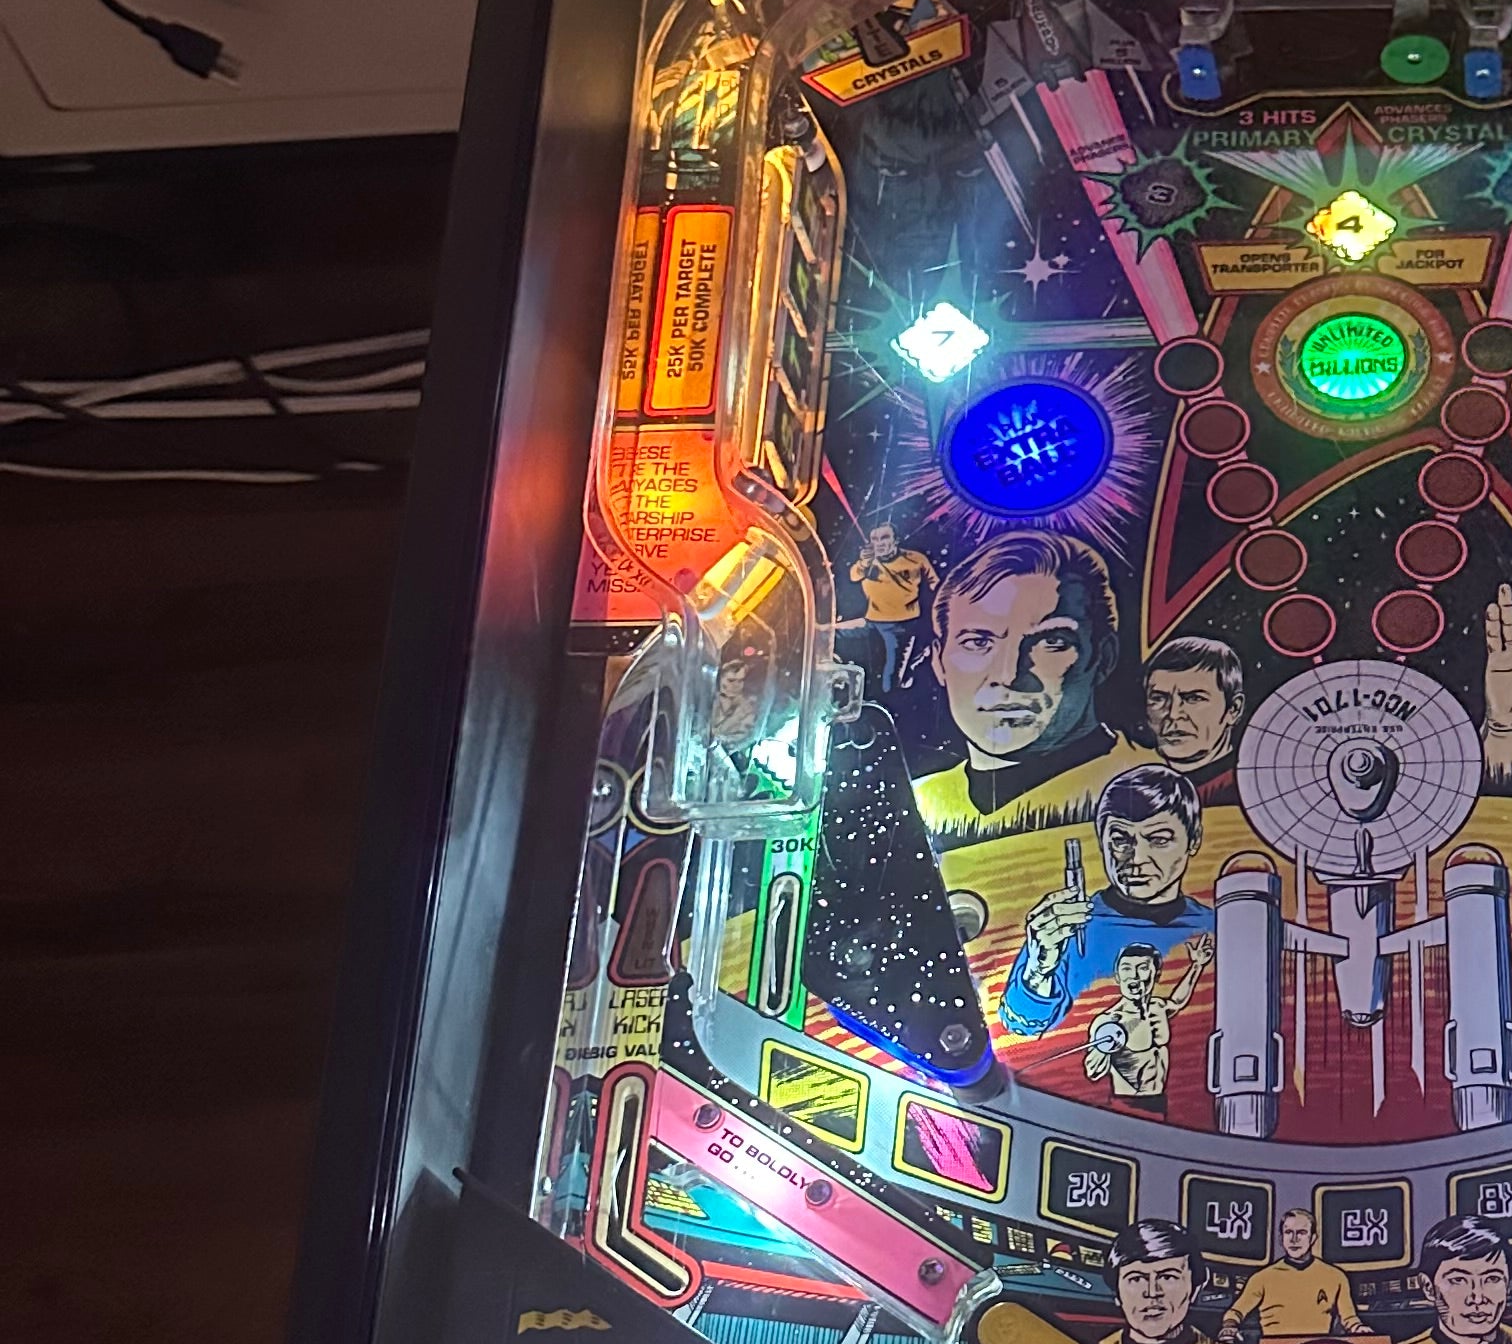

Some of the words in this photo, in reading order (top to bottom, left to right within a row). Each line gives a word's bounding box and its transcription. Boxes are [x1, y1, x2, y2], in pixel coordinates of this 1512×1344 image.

[852, 49, 943, 90] CRYSTALS
[1239, 111, 1256, 125] 3
[1262, 109, 1318, 125] HITS
[1192, 126, 1319, 148] PRIMARY
[1387, 122, 1512, 145] CRYSTAL
[1146, 182, 1178, 206] 3
[1336, 215, 1364, 234] 4
[1239, 252, 1291, 263] OPENS
[1396, 257, 1464, 270] JACKPOT
[1416, 249, 1445, 260] FOR
[675, 239, 697, 301] TARGET
[1210, 261, 1320, 274] TRANSPORTER
[694, 243, 717, 333] COMPLETE
[671, 301, 690, 340] PER
[931, 330, 955, 347] 7
[1311, 324, 1394, 353] UNLIMITED
[667, 345, 686, 378] 25K
[688, 338, 706, 372] 50K
[1310, 356, 1399, 377] MILLIONS
[654, 462, 691, 476] THE
[636, 494, 673, 508] THE
[1302, 688, 1417, 723] NCC-1701
[770, 838, 815, 854] 30K
[613, 1014, 662, 1035] KICK
[721, 1127, 745, 1148] TO
[745, 1144, 811, 1190] BOLDLY
[1065, 1170, 1112, 1208] 2X
[1204, 1200, 1253, 1240] 4X
[1340, 1208, 1390, 1248] 6X
